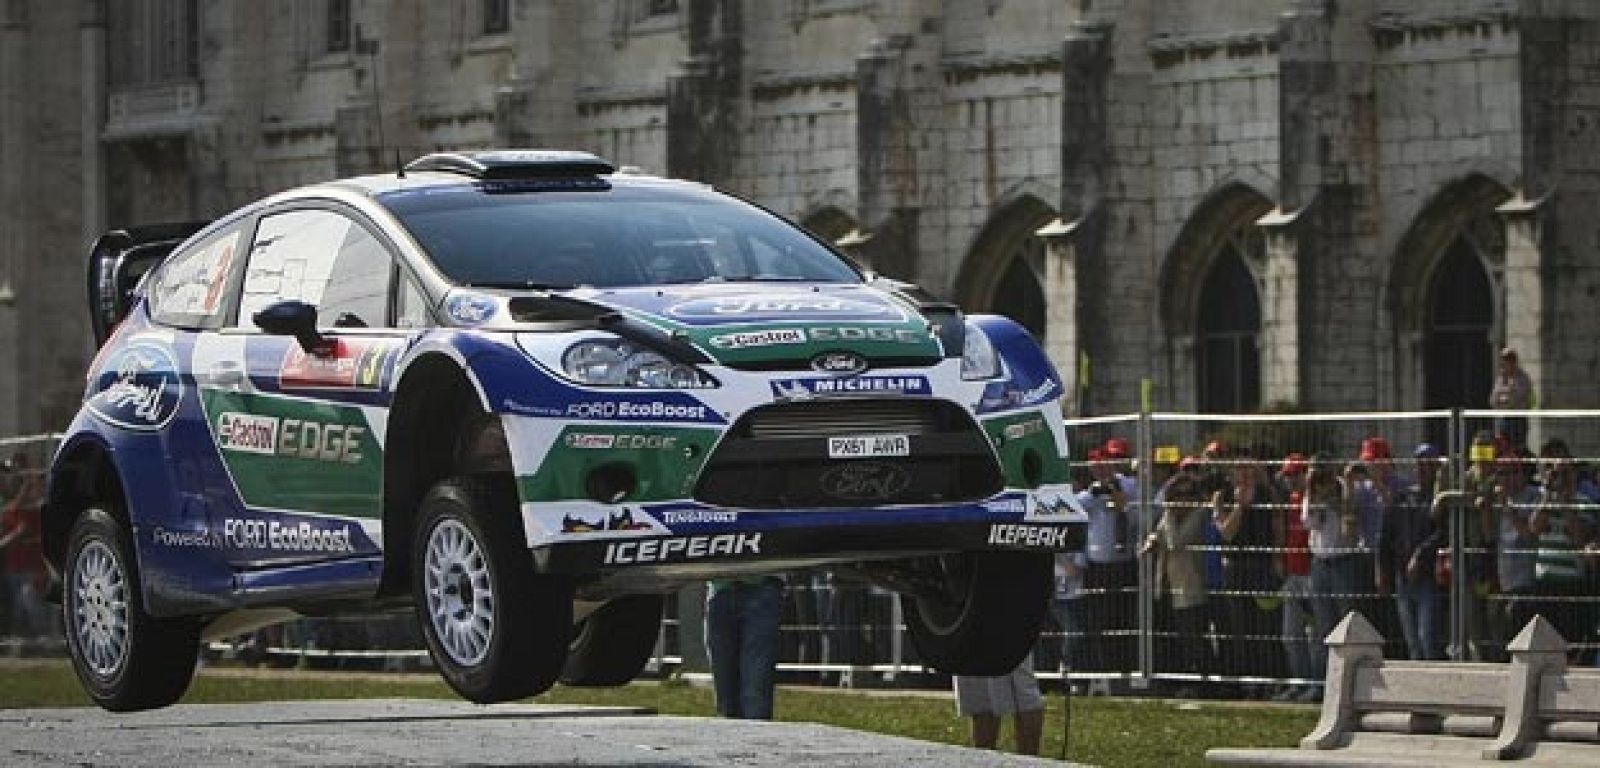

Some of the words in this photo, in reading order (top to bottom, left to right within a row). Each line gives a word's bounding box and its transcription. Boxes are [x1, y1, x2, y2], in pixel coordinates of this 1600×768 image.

[732, 328, 800, 345] Castrol
[808, 326, 918, 343] EDGE
[814, 377, 923, 392] MICHELIN
[566, 401, 616, 418] FORD
[618, 401, 706, 419] EcoBoost
[229, 415, 274, 450] Castrol
[280, 418, 364, 463] EDGE
[615, 434, 677, 449] EDGE
[153, 526, 208, 547] Powered
[224, 518, 267, 549] FORD
[269, 520, 352, 552] EcoBoost
[987, 523, 1069, 548] ICEPEAK
[602, 532, 763, 565] ICEPEAK
